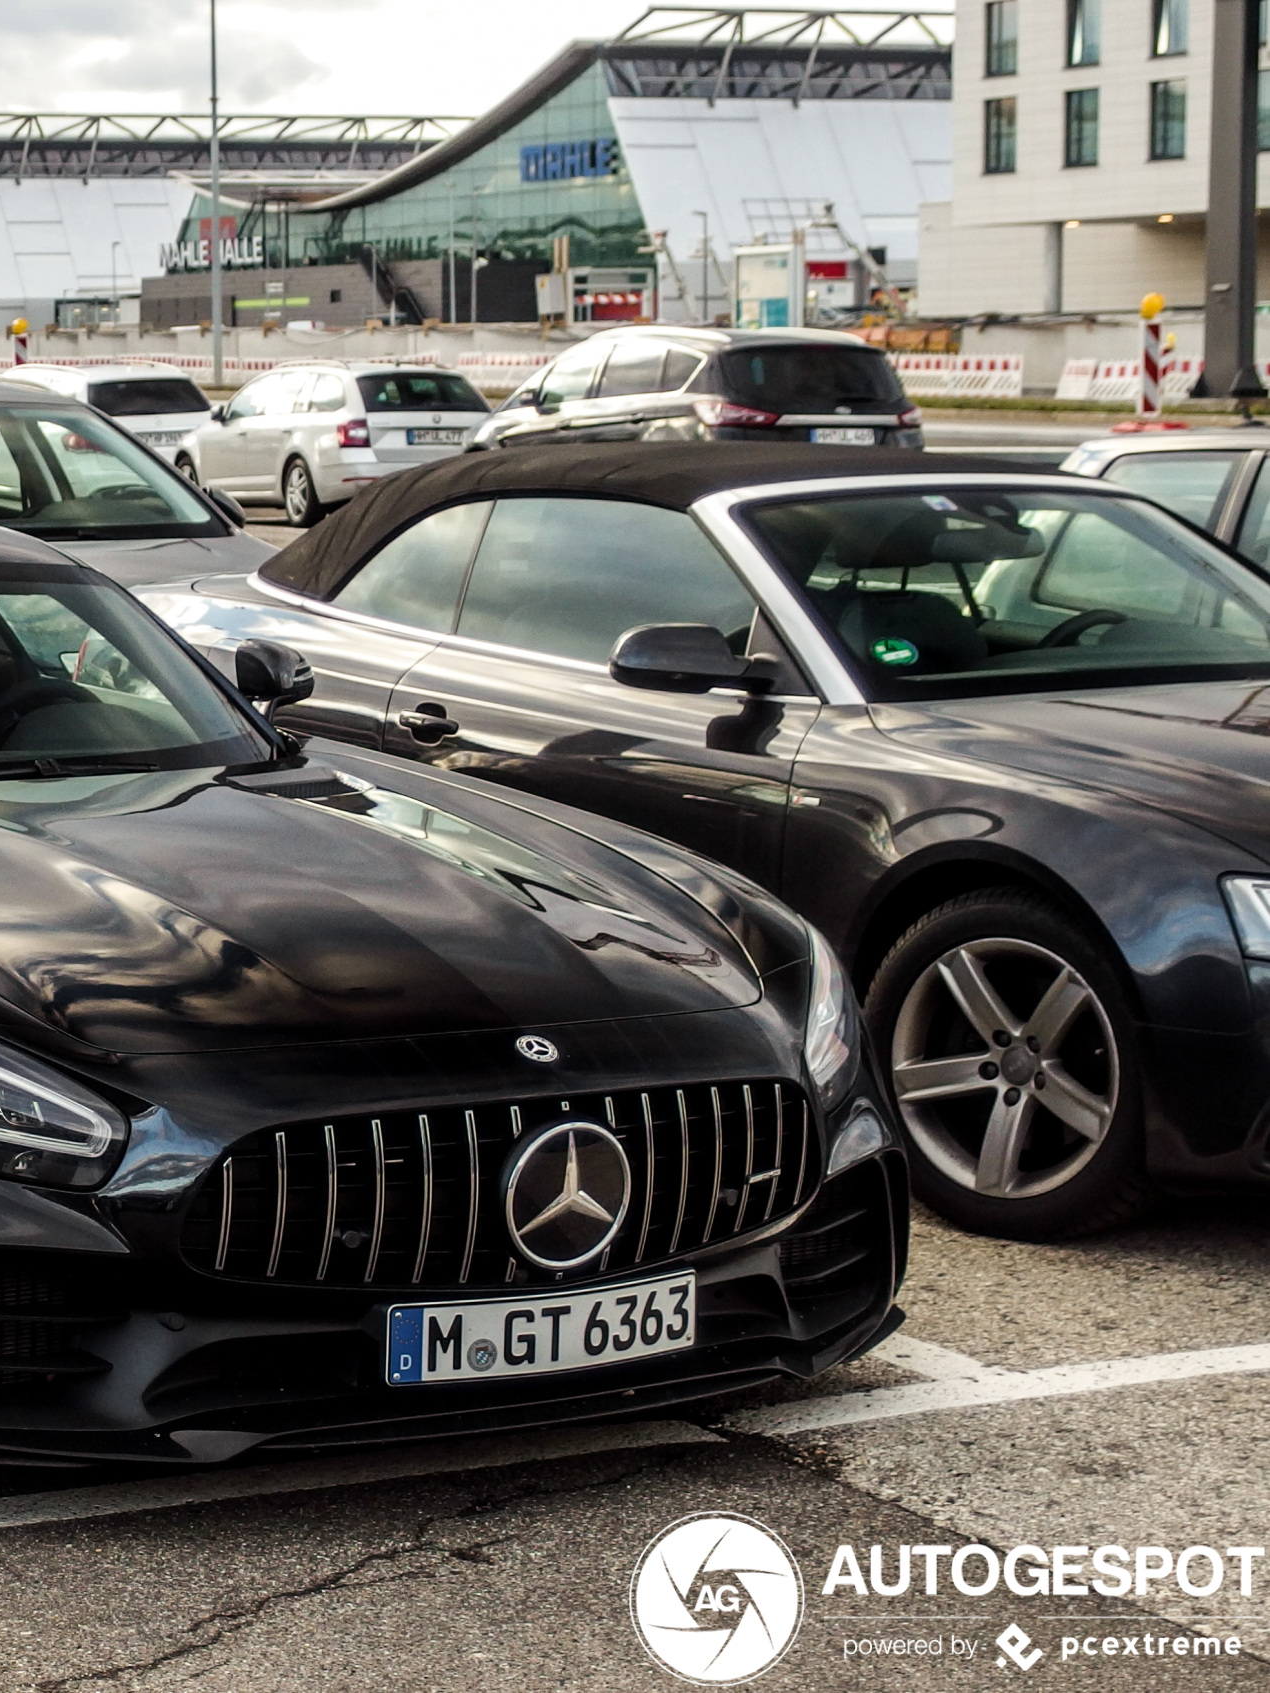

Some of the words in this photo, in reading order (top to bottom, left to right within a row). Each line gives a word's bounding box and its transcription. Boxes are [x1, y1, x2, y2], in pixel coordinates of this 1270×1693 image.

[520, 138, 612, 182] MAHLE
[427, 1313, 463, 1373] M
[503, 1305, 572, 1366] GT
[583, 1284, 690, 1357] 6363
[399, 1354, 412, 1370] D
